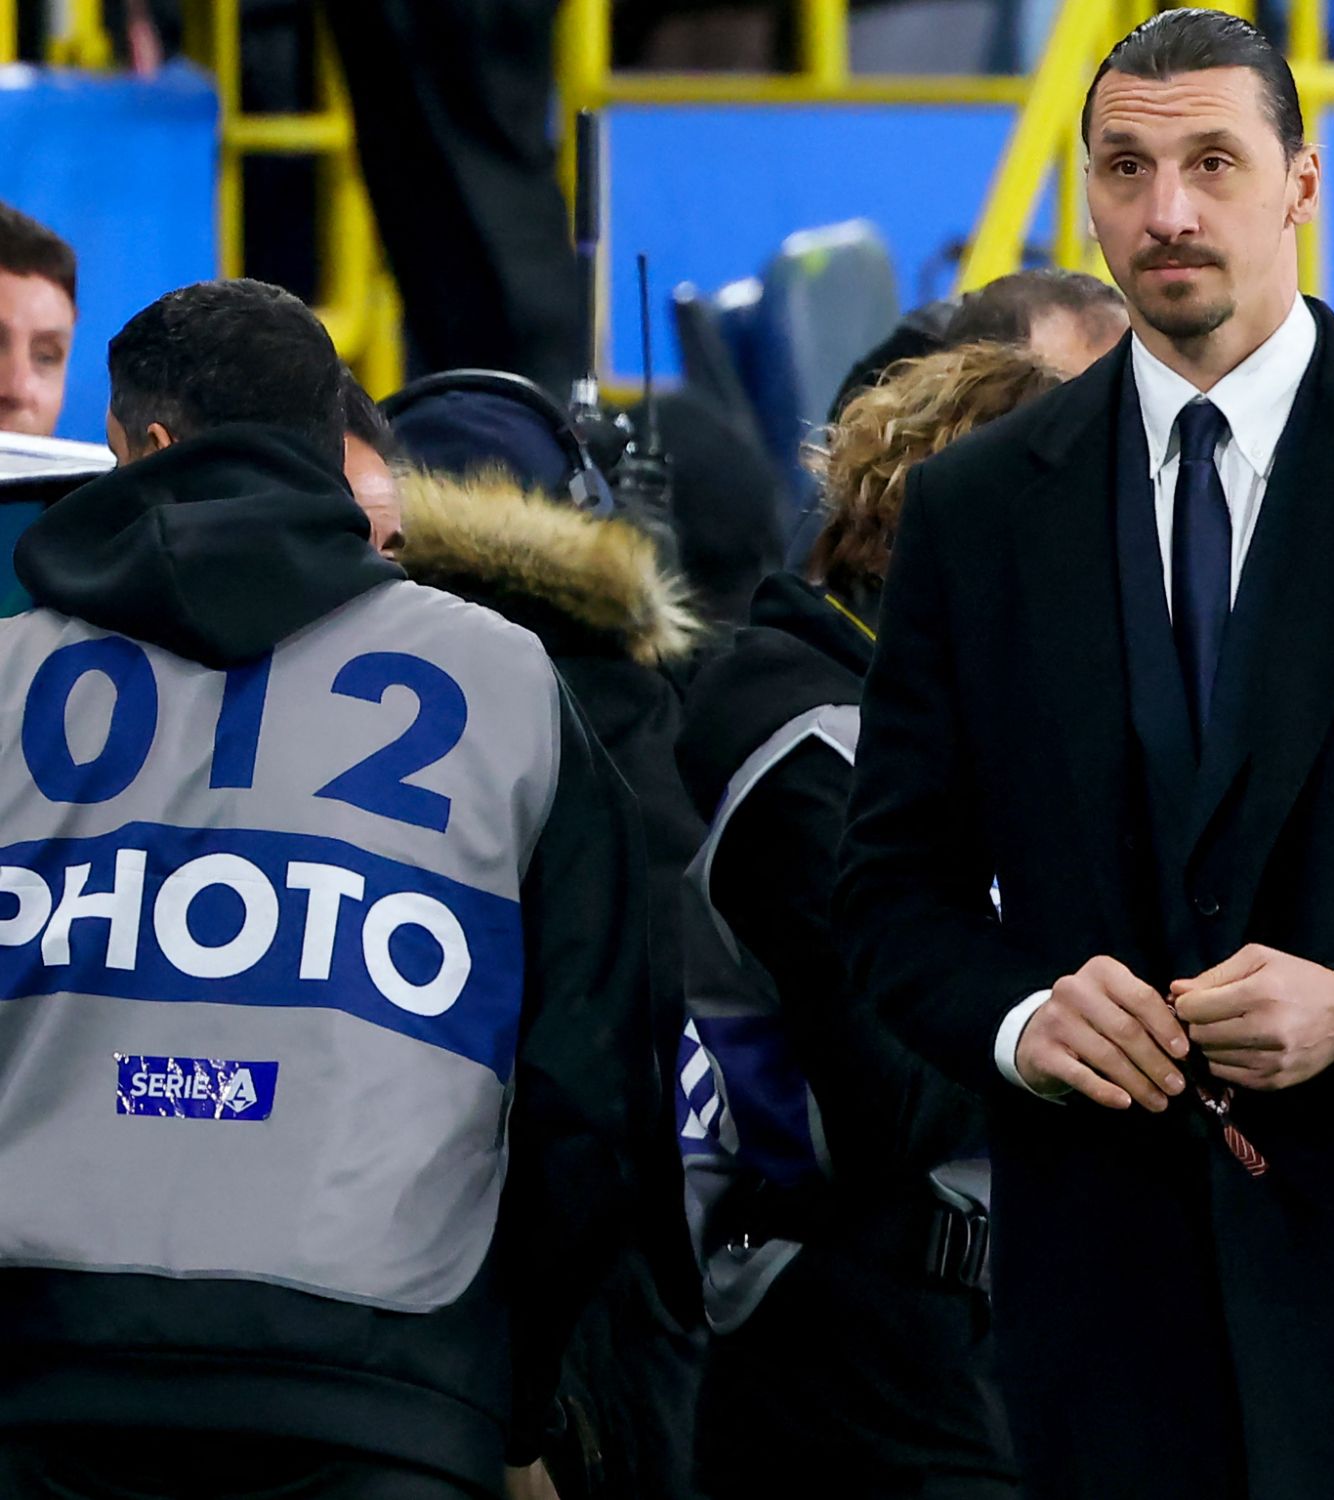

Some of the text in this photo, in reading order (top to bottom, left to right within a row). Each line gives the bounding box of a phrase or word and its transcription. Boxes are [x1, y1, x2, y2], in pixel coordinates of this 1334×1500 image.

[20, 635, 468, 834] 012
[129, 1067, 258, 1113] SERIE A
